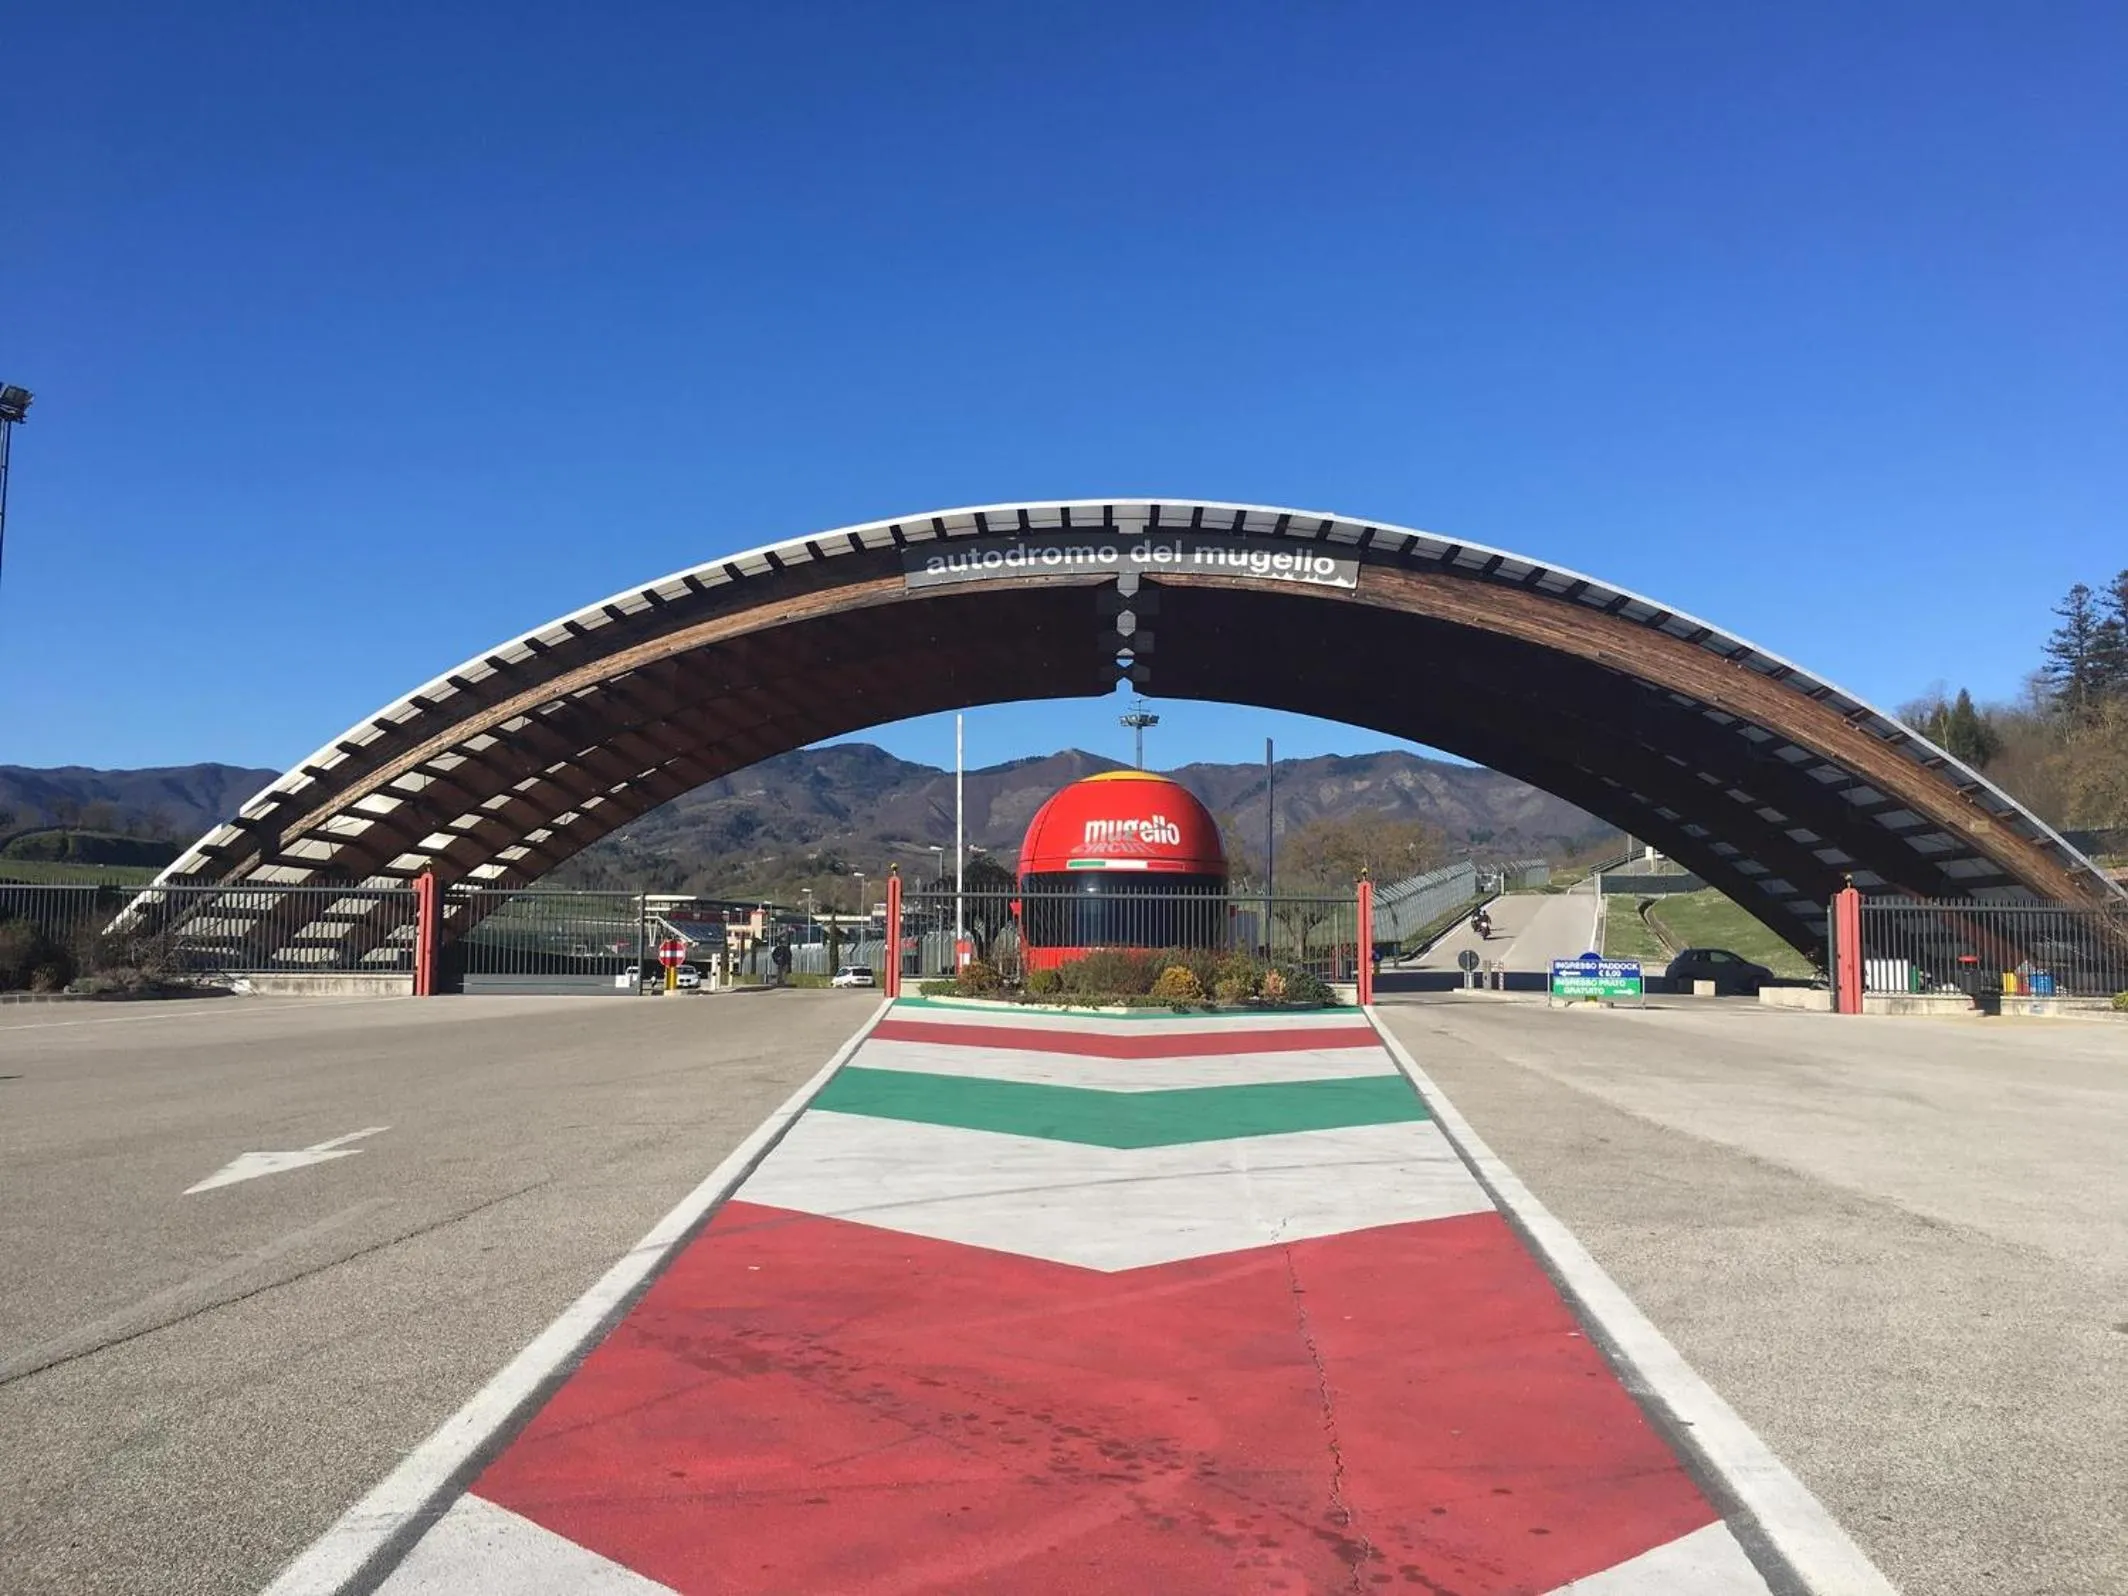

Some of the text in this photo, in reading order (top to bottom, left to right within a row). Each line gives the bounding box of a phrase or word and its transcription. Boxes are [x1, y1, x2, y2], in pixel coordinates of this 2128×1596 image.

[926, 539, 1335, 575] autodromo del mugello
[1085, 814, 1181, 846] mugello
[1555, 962, 1639, 970] INGRESSO PADDOCK
[1554, 978, 1626, 987] INGRESSO PRATO
[1563, 987, 1606, 995] GRATUITO
